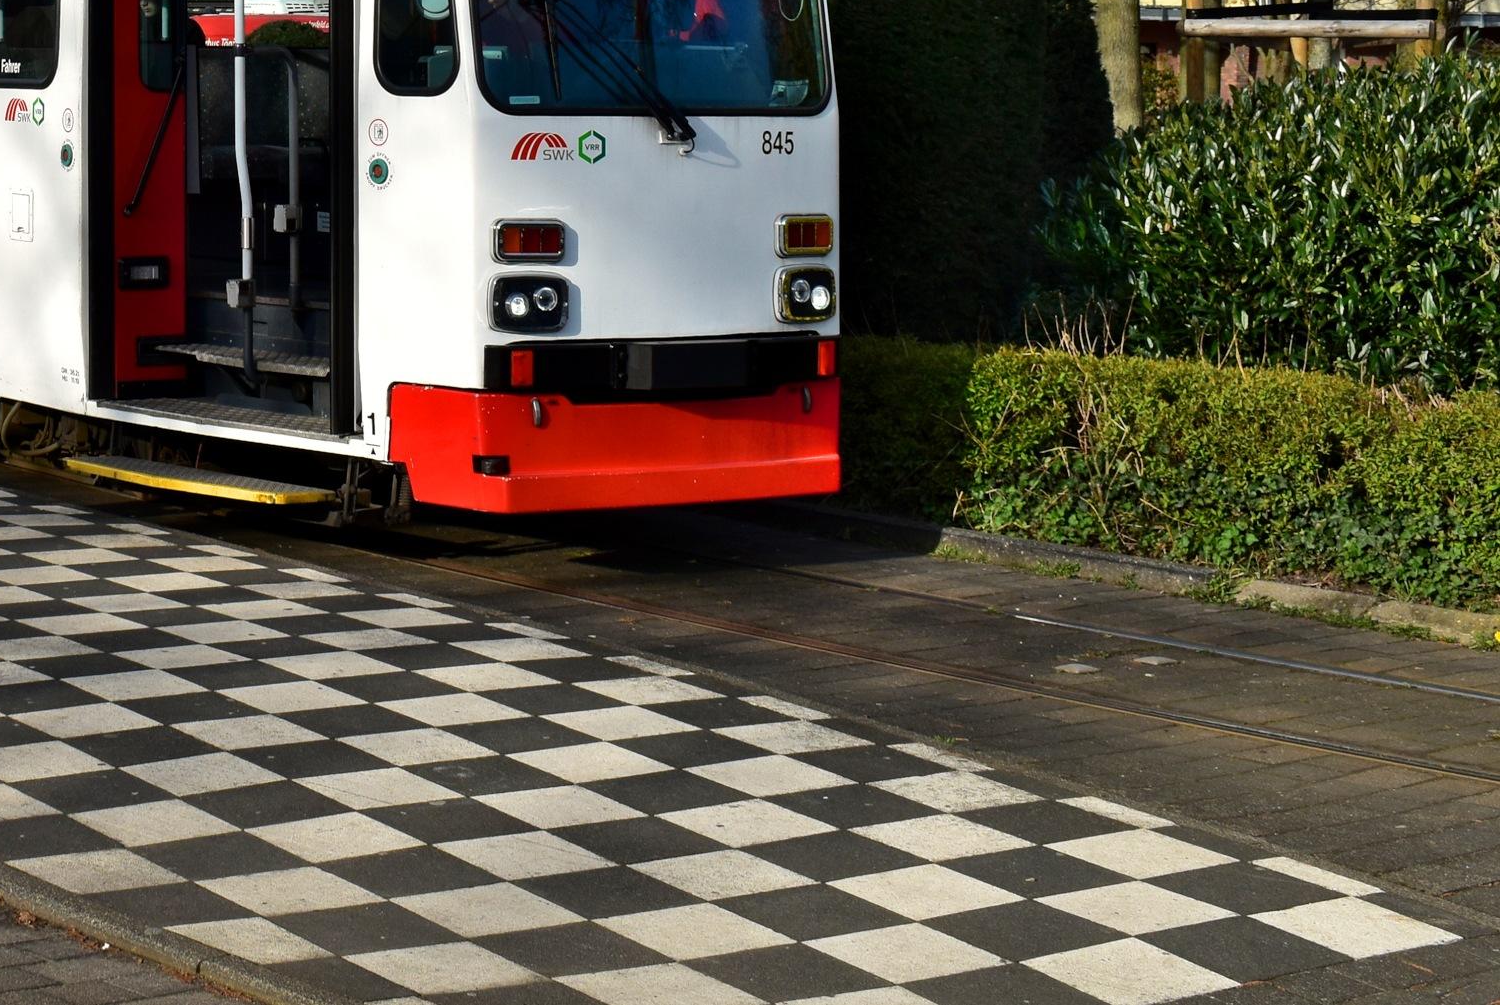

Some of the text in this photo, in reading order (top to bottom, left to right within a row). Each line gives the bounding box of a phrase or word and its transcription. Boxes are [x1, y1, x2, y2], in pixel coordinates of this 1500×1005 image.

[1, 58, 21, 74] Fahrer
[17, 112, 31, 123] SWK
[761, 130, 794, 155] 845
[543, 143, 600, 161] SWK VRR
[367, 412, 376, 436] 1
